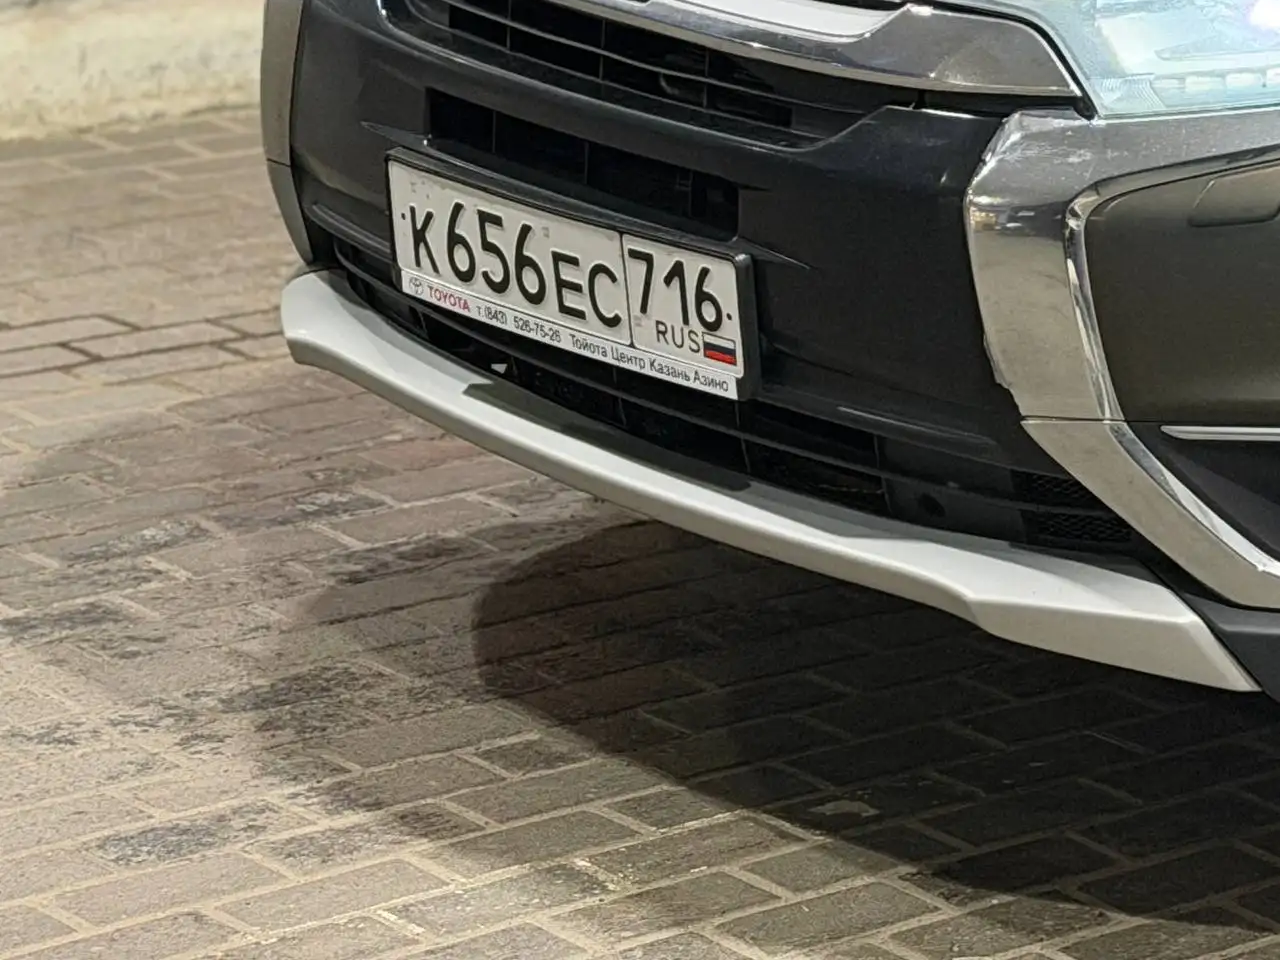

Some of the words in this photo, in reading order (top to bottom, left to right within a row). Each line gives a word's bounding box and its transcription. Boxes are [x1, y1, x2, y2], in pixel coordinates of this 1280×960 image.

[427, 285, 471, 313] TOYOTA
[627, 247, 724, 332] 716
[655, 319, 701, 354] RUS
[569, 334, 608, 357] Тойота
[610, 346, 646, 370] Центр
[649, 358, 691, 382] Казань
[692, 370, 729, 392] Азино
